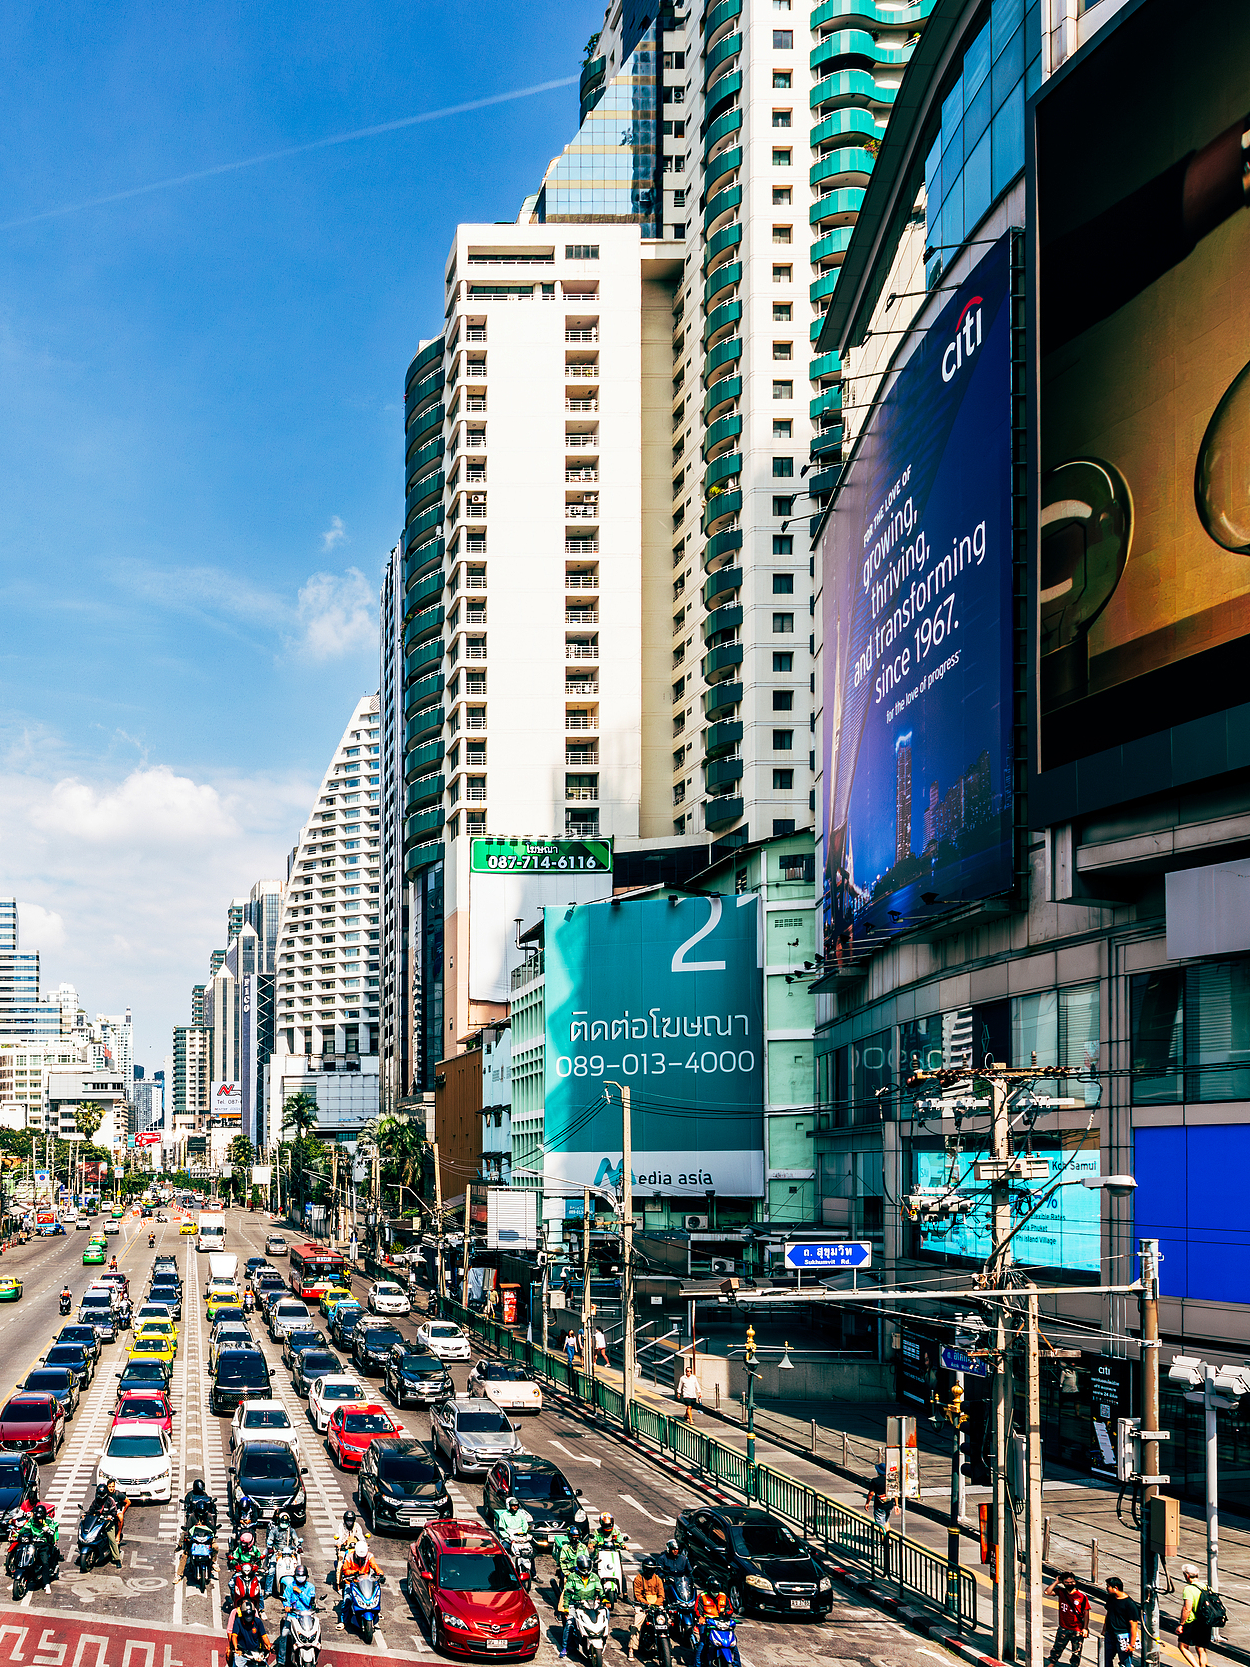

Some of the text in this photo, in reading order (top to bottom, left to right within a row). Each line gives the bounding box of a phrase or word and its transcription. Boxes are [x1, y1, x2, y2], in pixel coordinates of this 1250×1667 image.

[941, 307, 982, 383] citi
[863, 463, 912, 548] FOR THE LOVE OF
[863, 496, 918, 595] growing,
[871, 531, 930, 620] thriving,
[854, 520, 986, 688] and transforming
[875, 592, 959, 704] since 1967.
[886, 706, 895, 724] for
[895, 699, 905, 716] the
[905, 686, 919, 706] love
[919, 675, 928, 694] of
[487, 855, 597, 869] 087-714-6116
[525, 841, 559, 854] โฆษณา
[570, 1007, 749, 1042] ติดต่อโฆษณา
[555, 1050, 756, 1078] 089-013-4000
[678, 1168, 713, 1186] asia
[1070, 1160, 1097, 1171] Samui
[816, 1244, 853, 1260] สุขุมวิท
